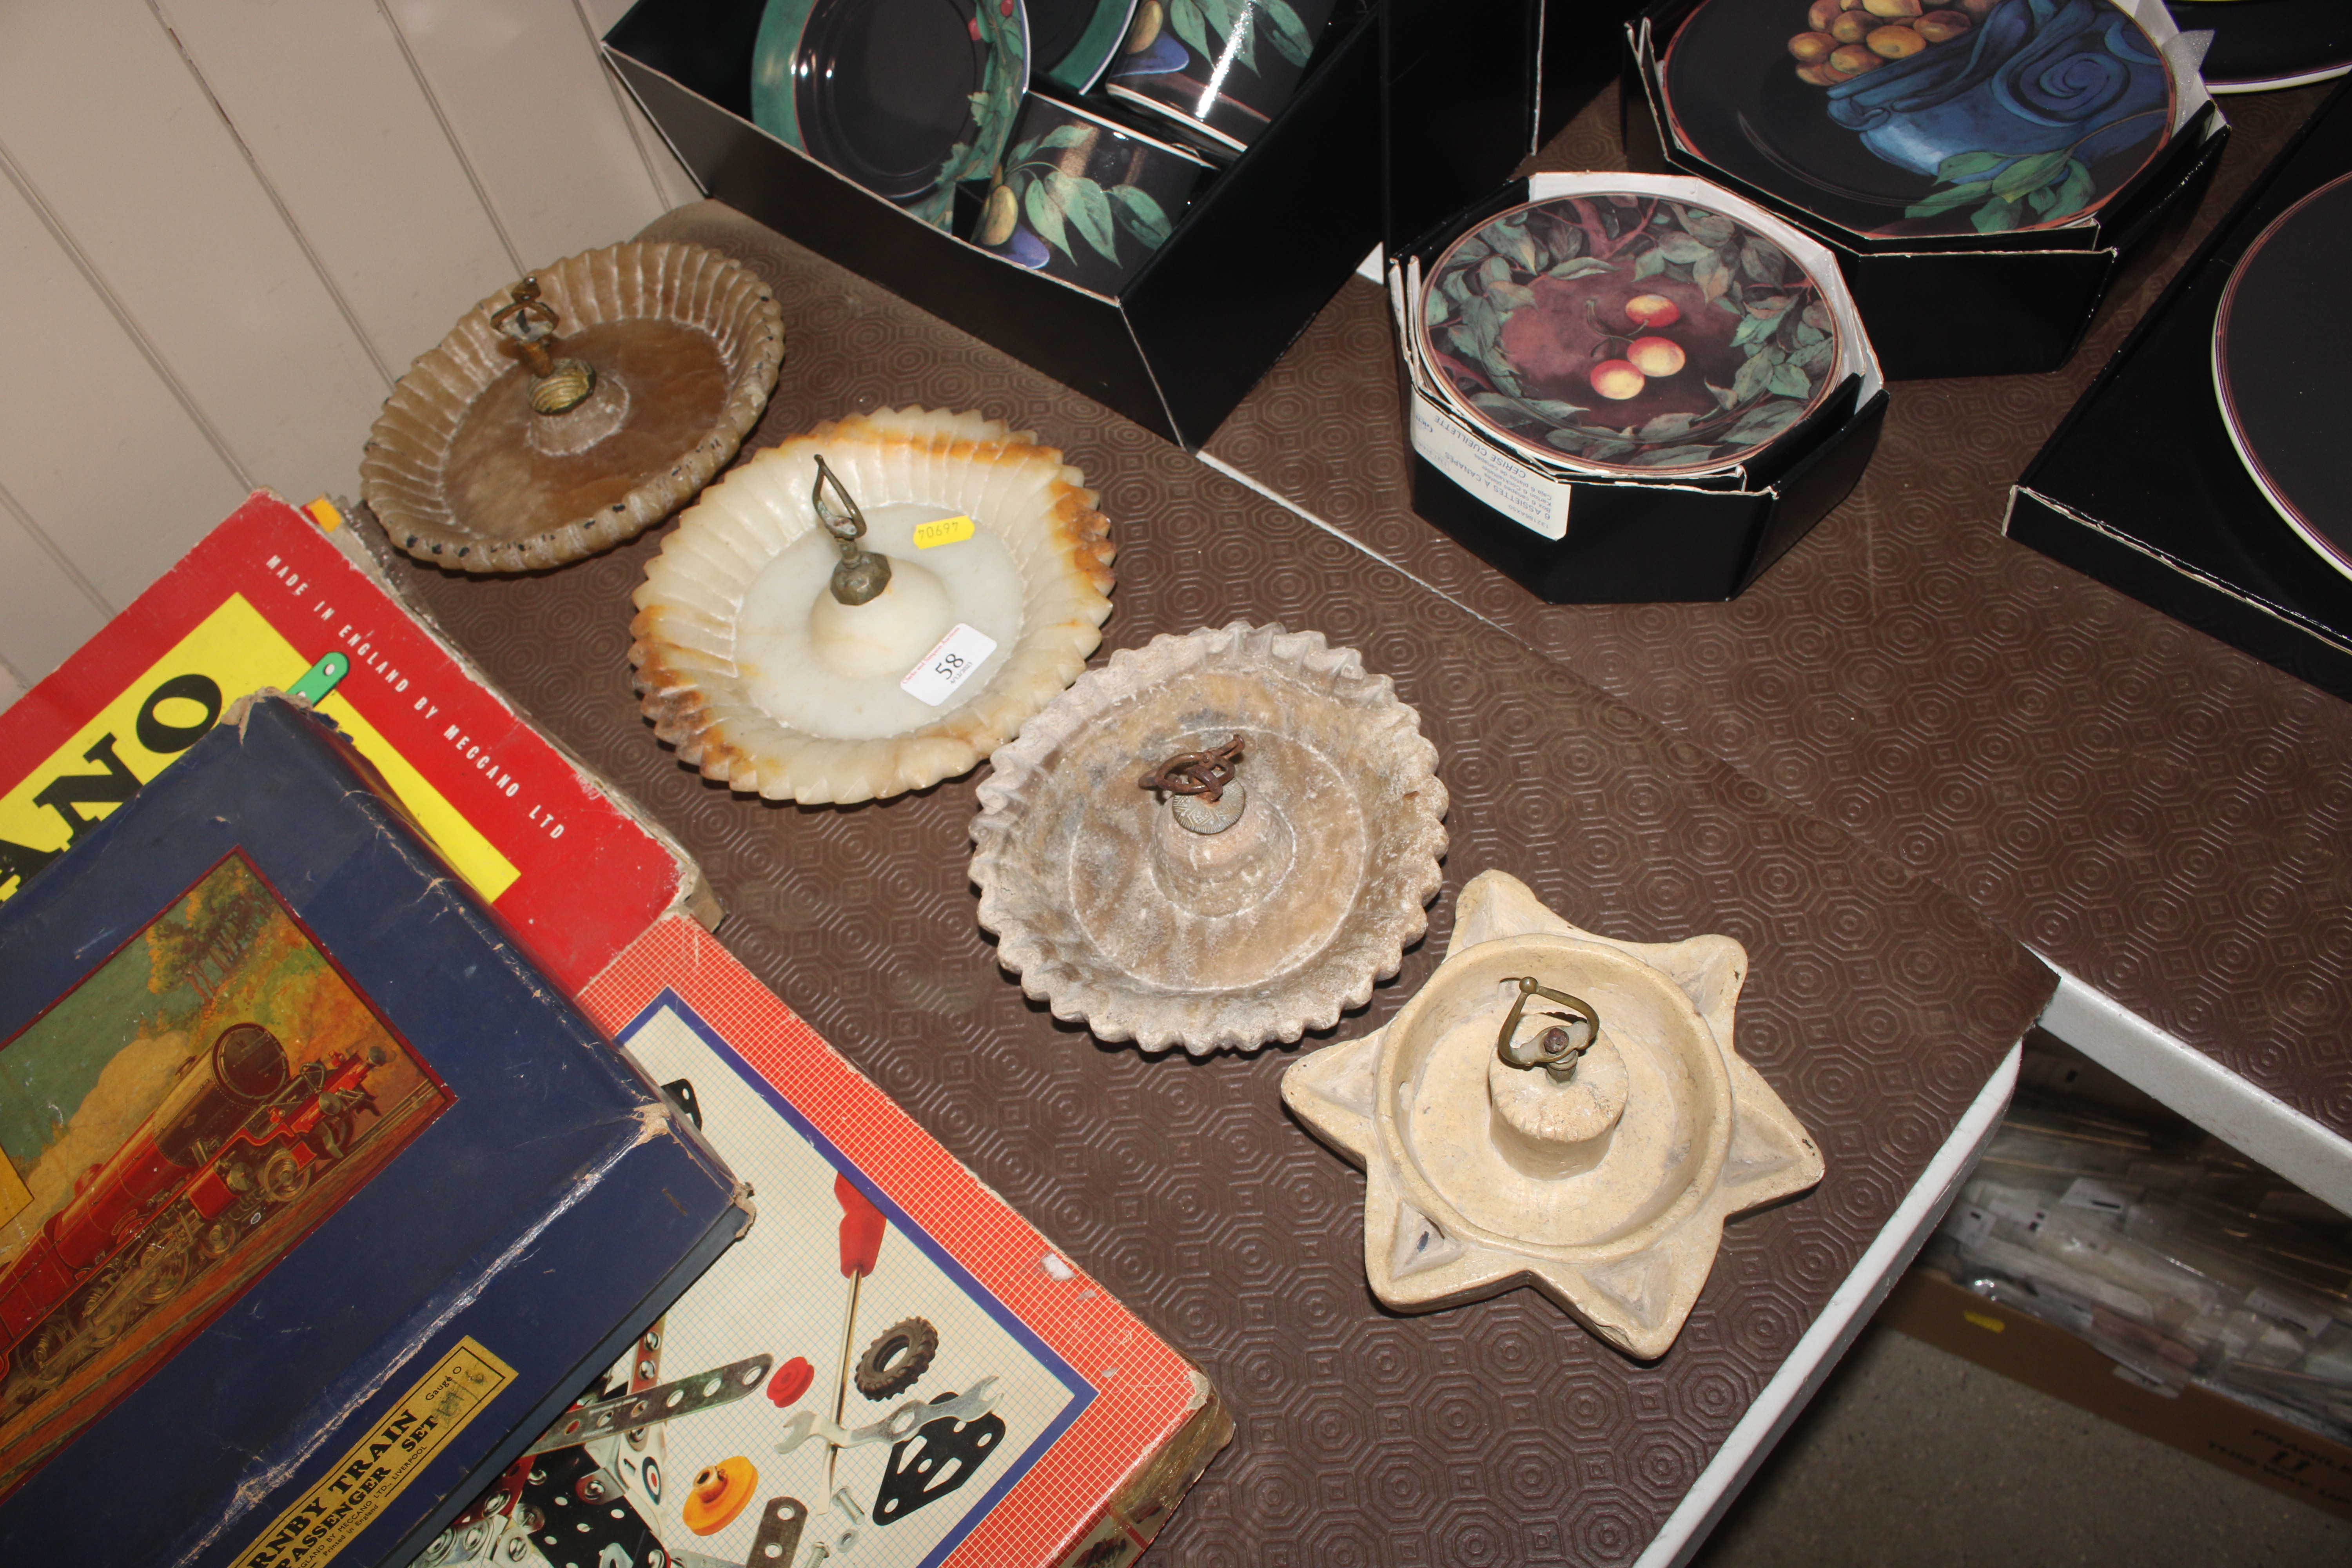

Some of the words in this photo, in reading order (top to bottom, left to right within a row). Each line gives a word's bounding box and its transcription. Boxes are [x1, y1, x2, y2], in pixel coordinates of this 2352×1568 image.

[1434, 415, 1488, 456] CUEILLETTE
[1490, 454, 1526, 478] CERISE
[1510, 475, 1529, 488] platos
[1493, 485, 1541, 515] ASSIETTES
[1530, 492, 1552, 507] Karton
[1537, 490, 1552, 501] Caja
[1539, 504, 1551, 513] Box
[918, 522, 958, 540] 70697
[935, 653, 964, 680] 58
[266, 554, 309, 596] MADE
[314, 600, 335, 621] IN
[338, 624, 410, 693] ENGLAND
[414, 696, 439, 719] BY
[443, 724, 520, 797] MECCANO
[528, 804, 565, 839] LTD
[425, 1376, 453, 1401] Gauge
[247, 1497, 328, 1568] RNBY
[328, 1410, 418, 1495] TRAIN
[274, 1466, 391, 1568] PASSENGER
[401, 1415, 438, 1453] SET
[326, 1533, 336, 1543] BY
[338, 1500, 372, 1533] MECCANO
[392, 1445, 427, 1480] LIVERPOOL
[323, 1535, 346, 1557] Printed
[355, 1504, 379, 1527] England
